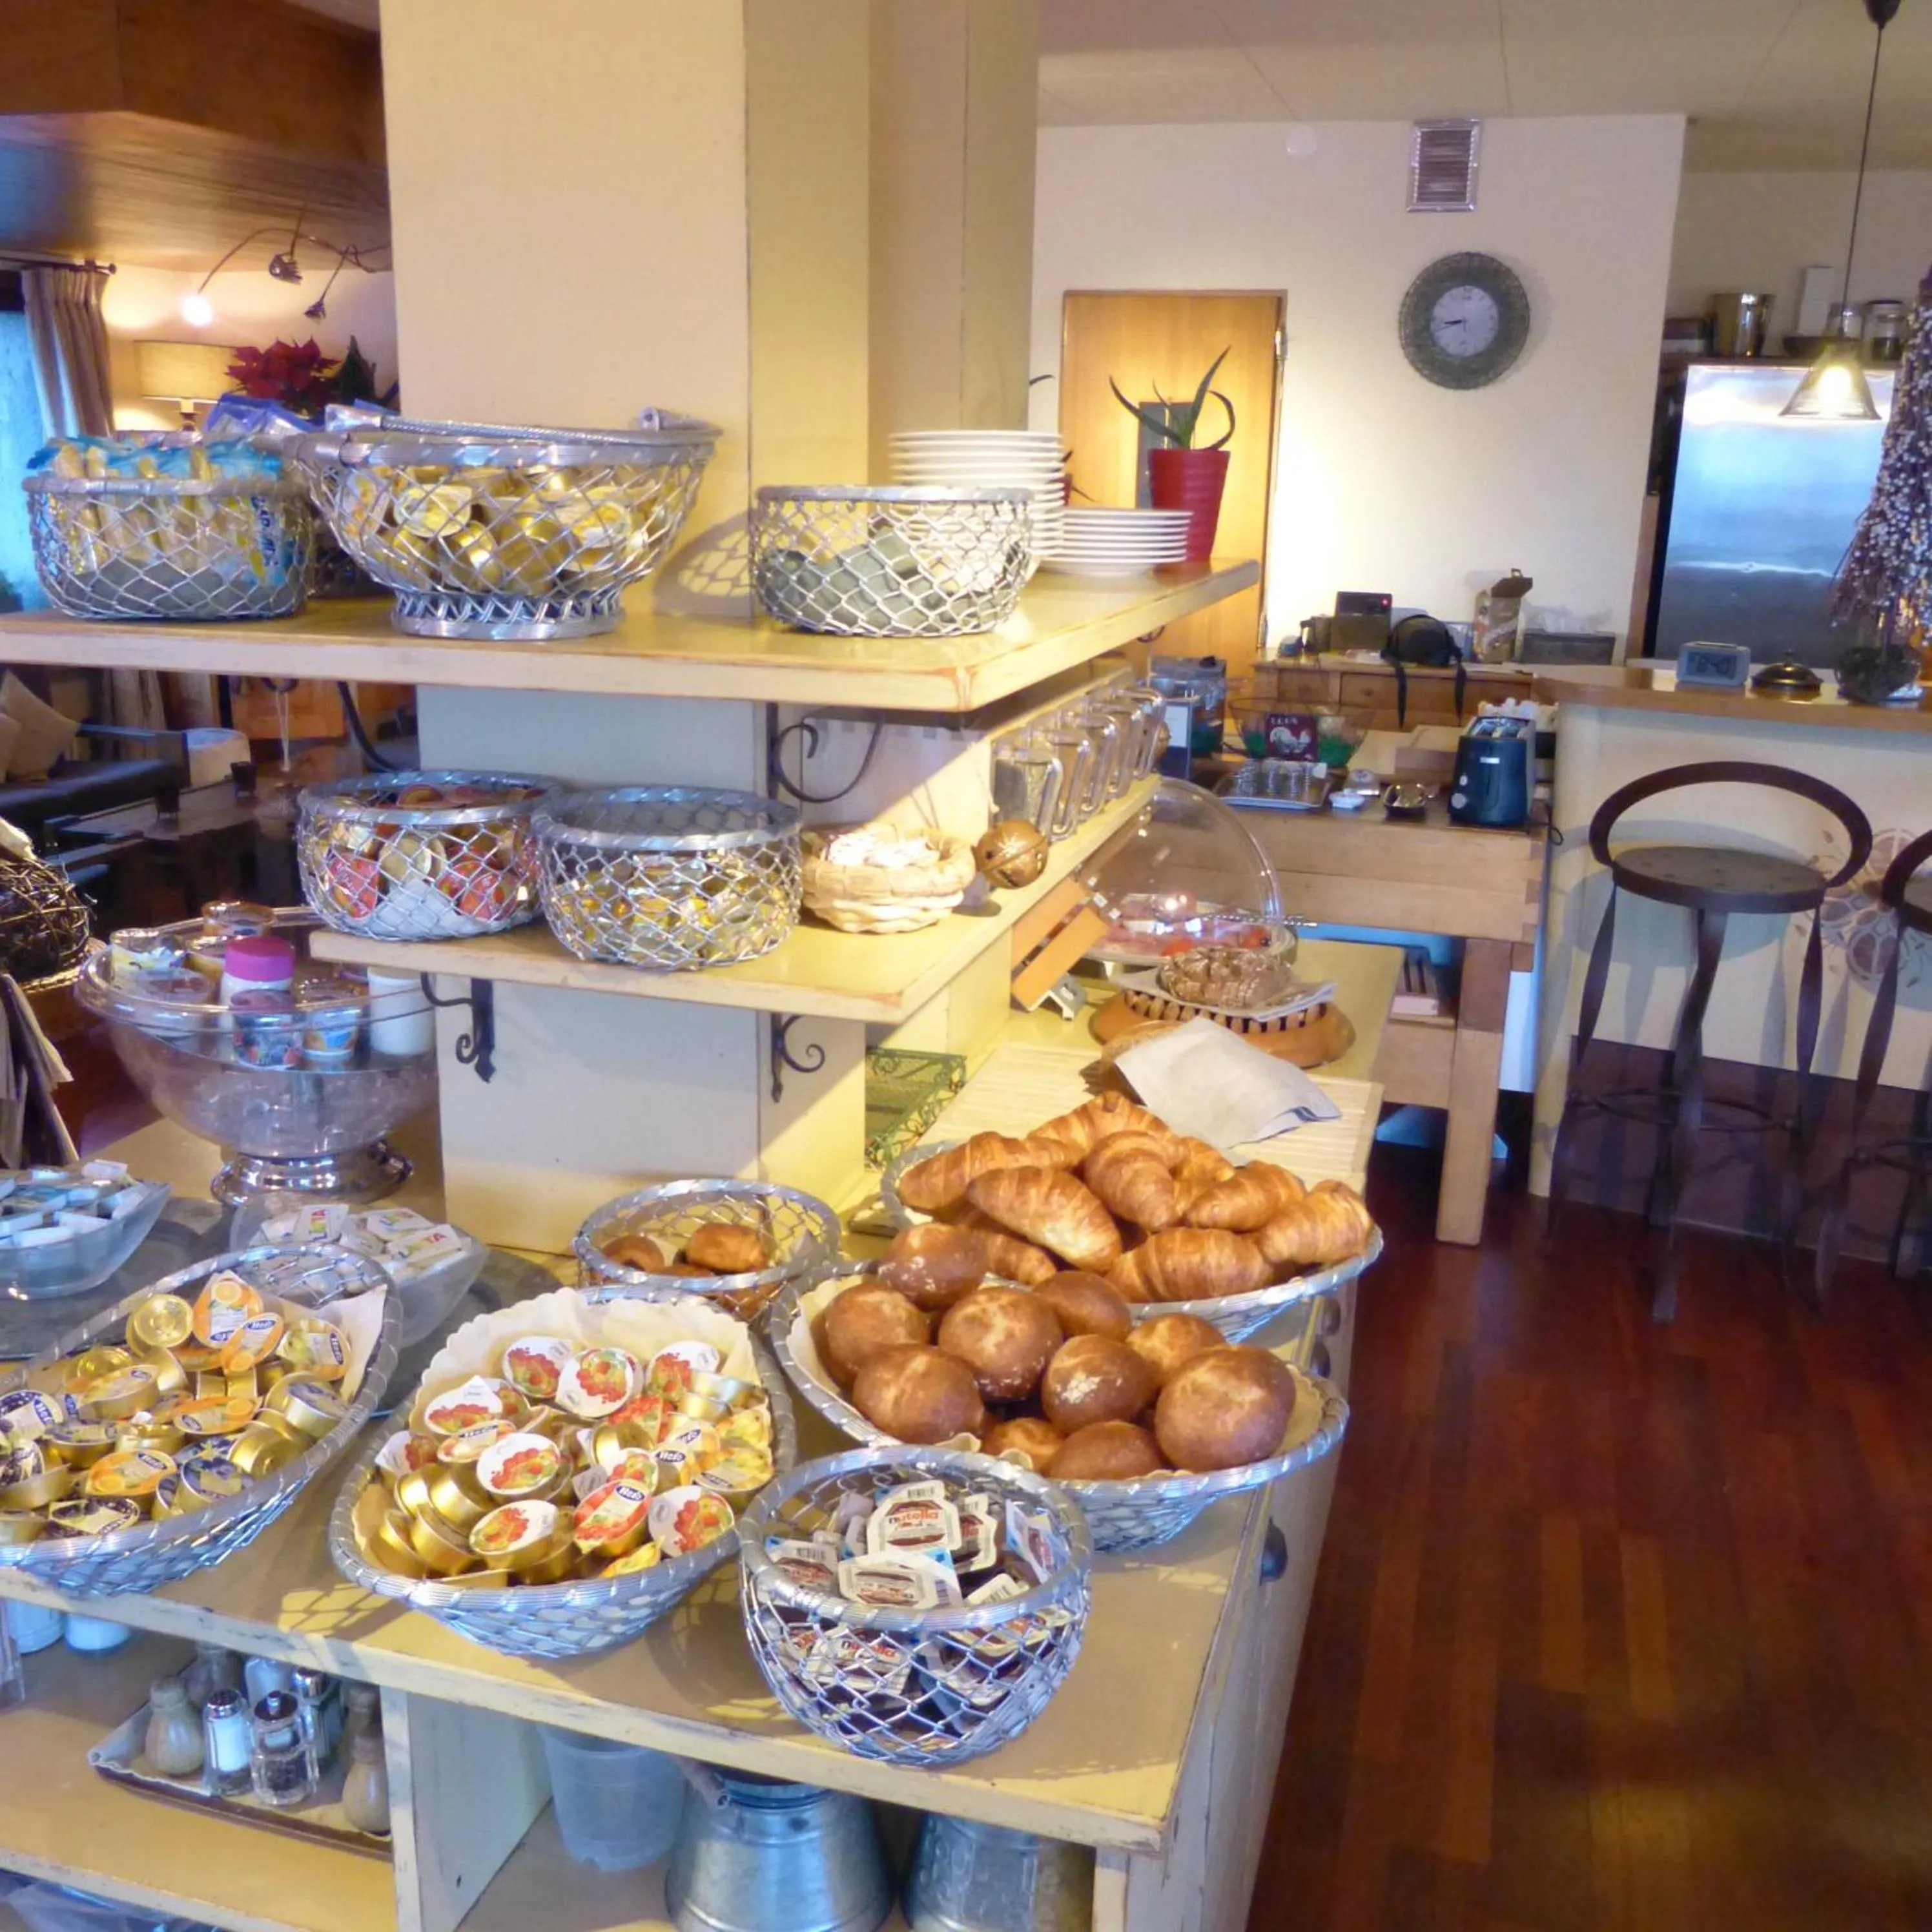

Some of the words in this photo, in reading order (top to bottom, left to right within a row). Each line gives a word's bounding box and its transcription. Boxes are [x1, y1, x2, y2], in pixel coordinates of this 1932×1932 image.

[659, 1452, 683, 1461] Hero
[619, 1486, 642, 1500] Hero
[889, 1508, 938, 1524] nutella
[841, 1639, 896, 1658] nulla
